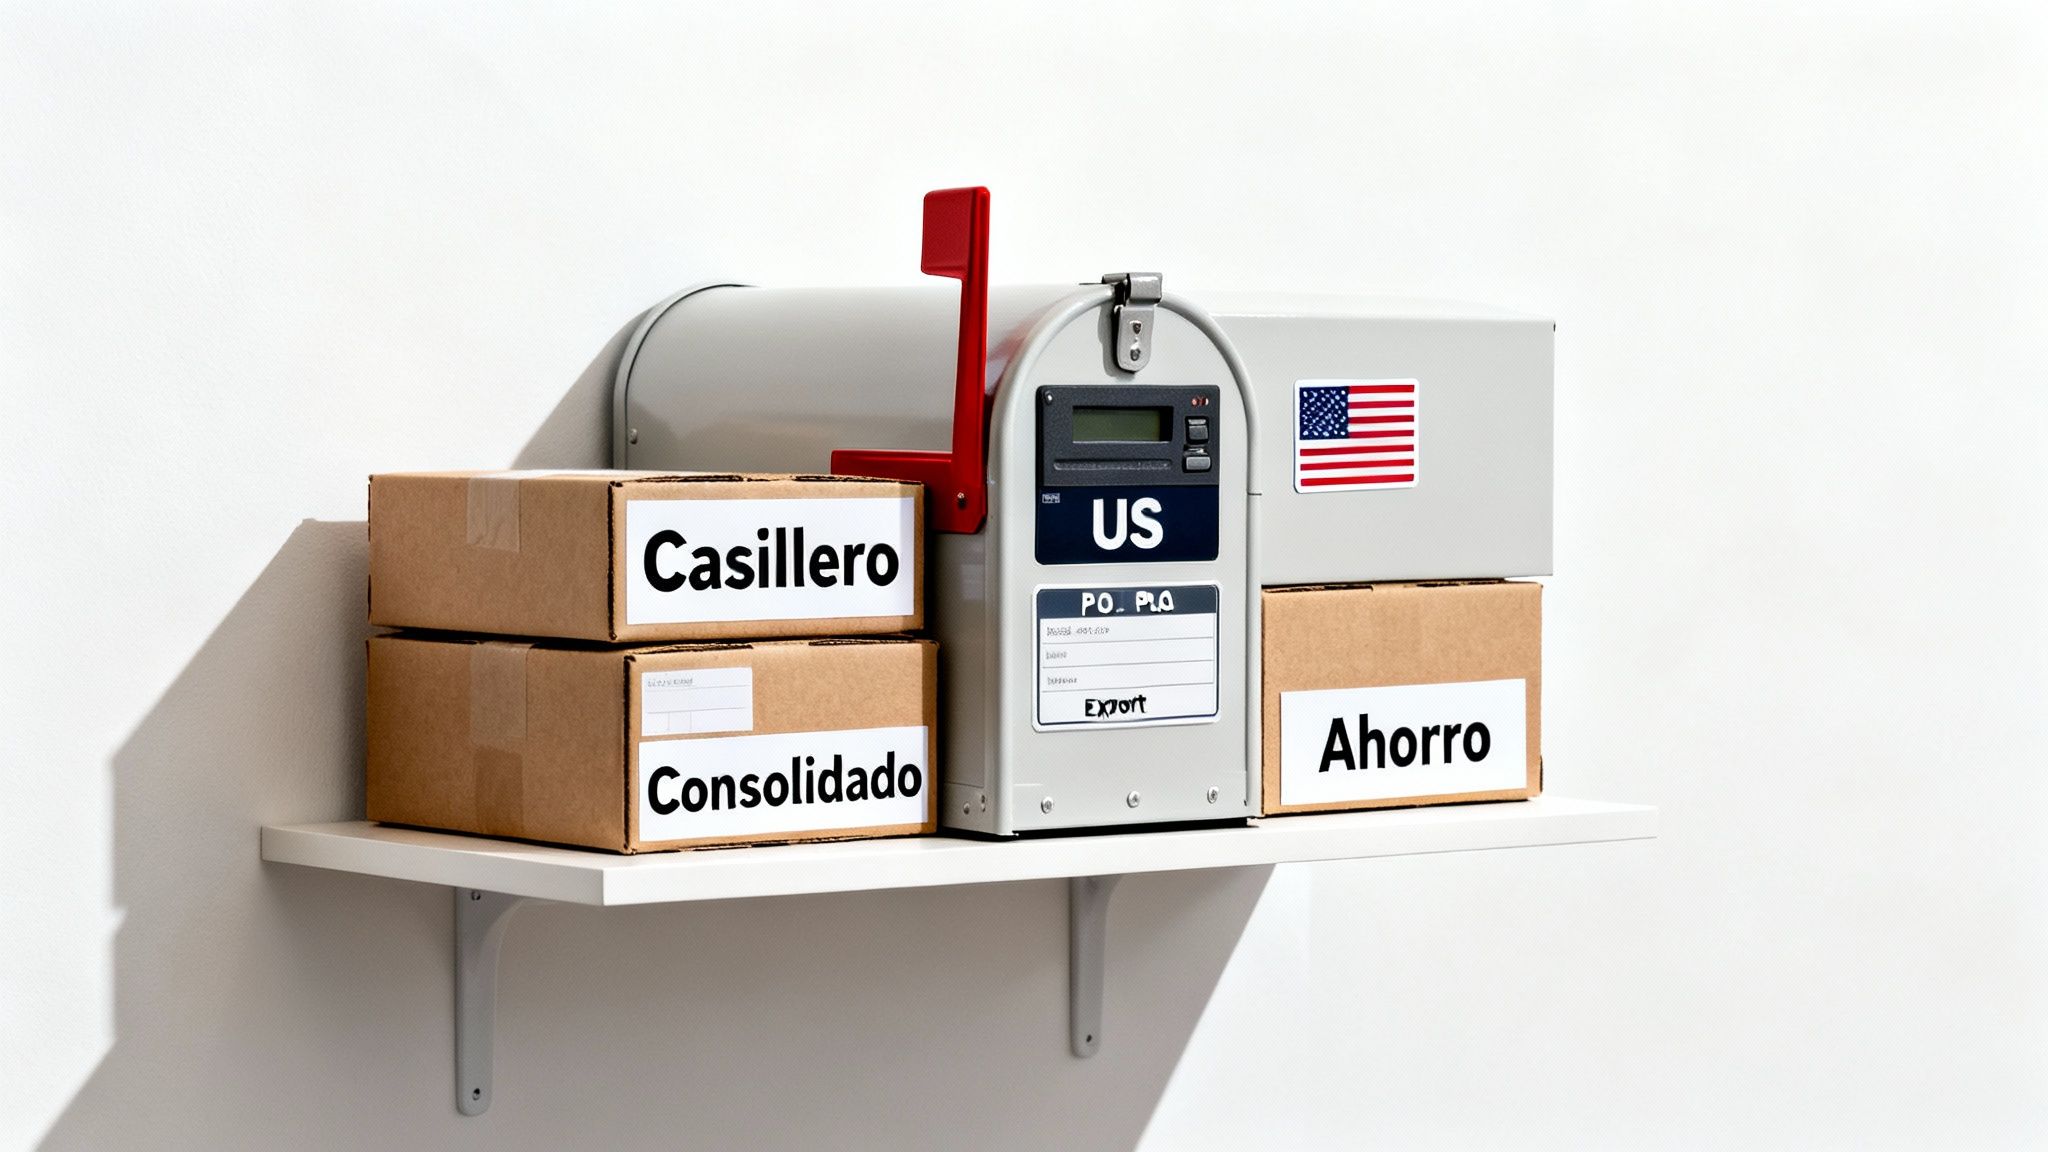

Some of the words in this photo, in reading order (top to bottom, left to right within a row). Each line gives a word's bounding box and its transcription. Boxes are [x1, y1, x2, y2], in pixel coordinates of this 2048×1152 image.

[1092, 497, 1164, 551] US
[643, 526, 900, 593] Casillero
[1318, 713, 1492, 773] Ahorro
[647, 750, 923, 816] Consolidado
